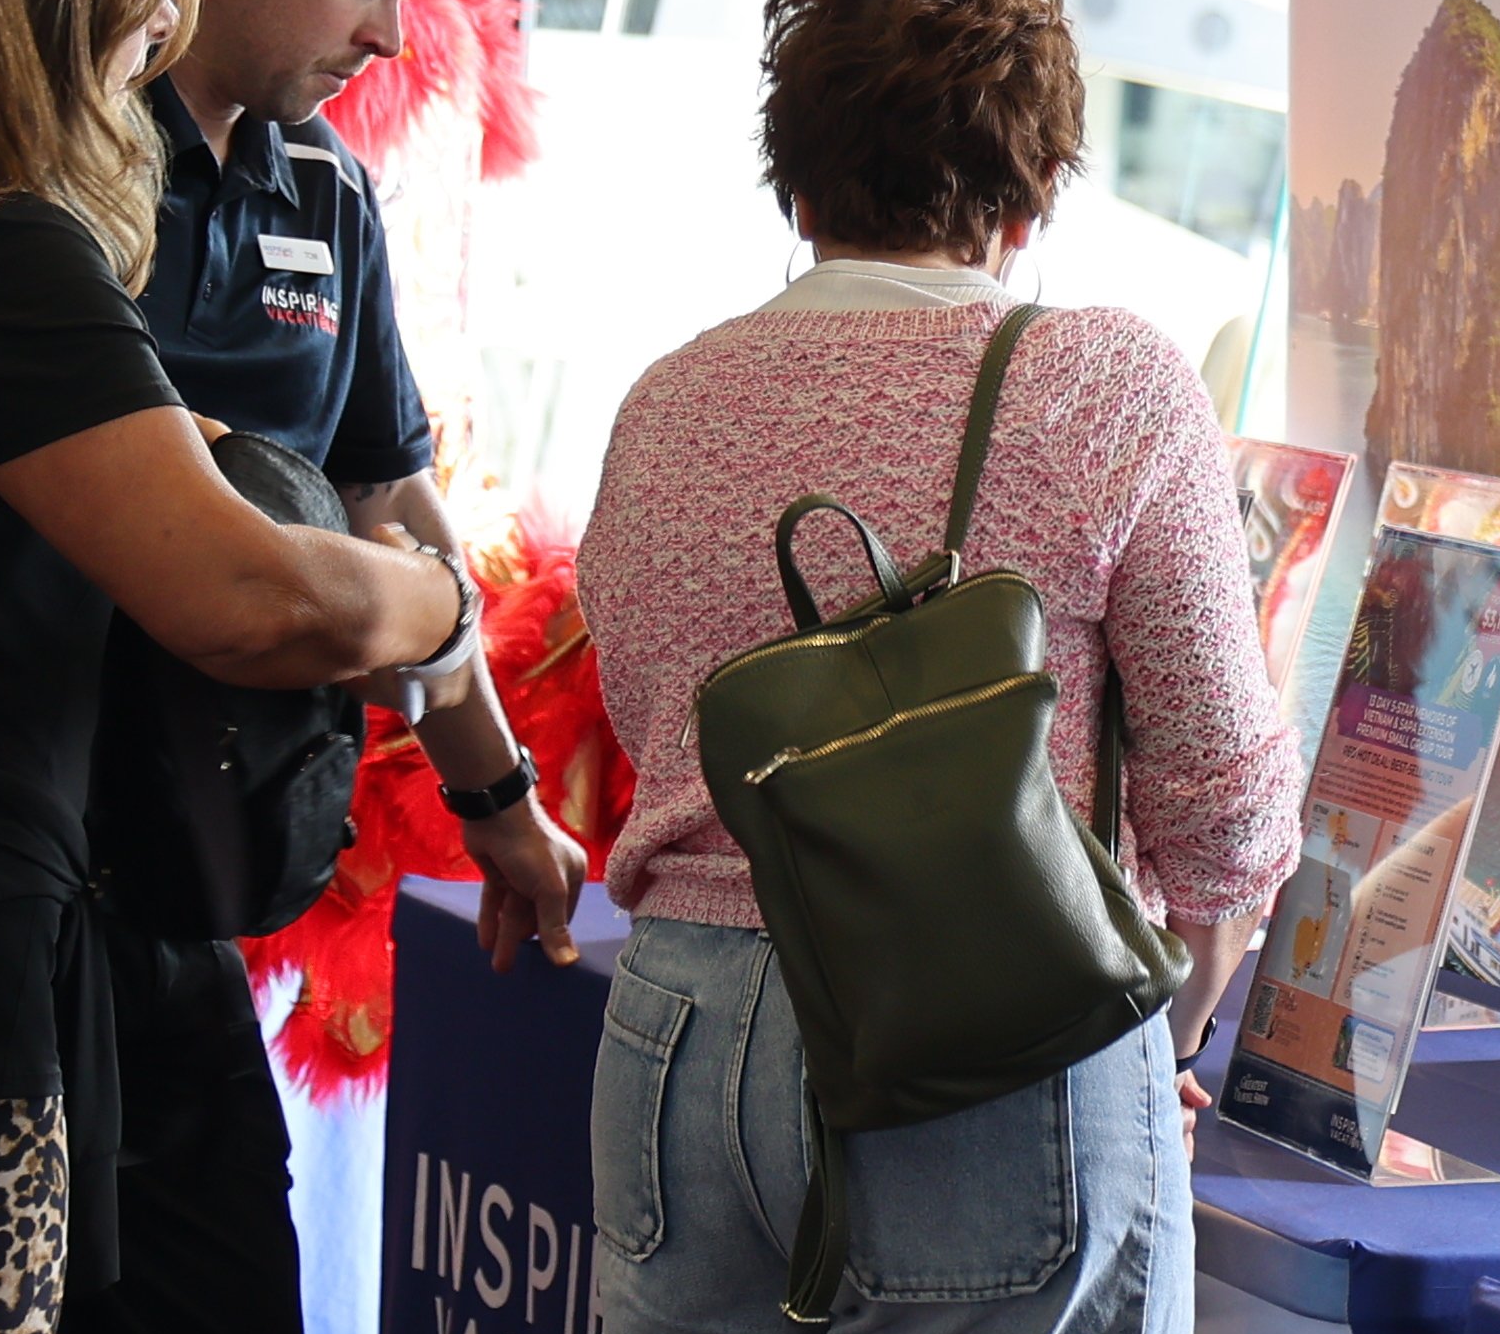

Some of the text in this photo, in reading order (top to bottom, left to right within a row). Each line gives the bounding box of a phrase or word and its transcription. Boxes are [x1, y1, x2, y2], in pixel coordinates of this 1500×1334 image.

[1376, 696, 1391, 711] DAY
[1356, 724, 1387, 742] PREMIUM
[1388, 730, 1409, 748] SMALL
[1364, 710, 1456, 743] VIETNAM SAPA EXTENSION
